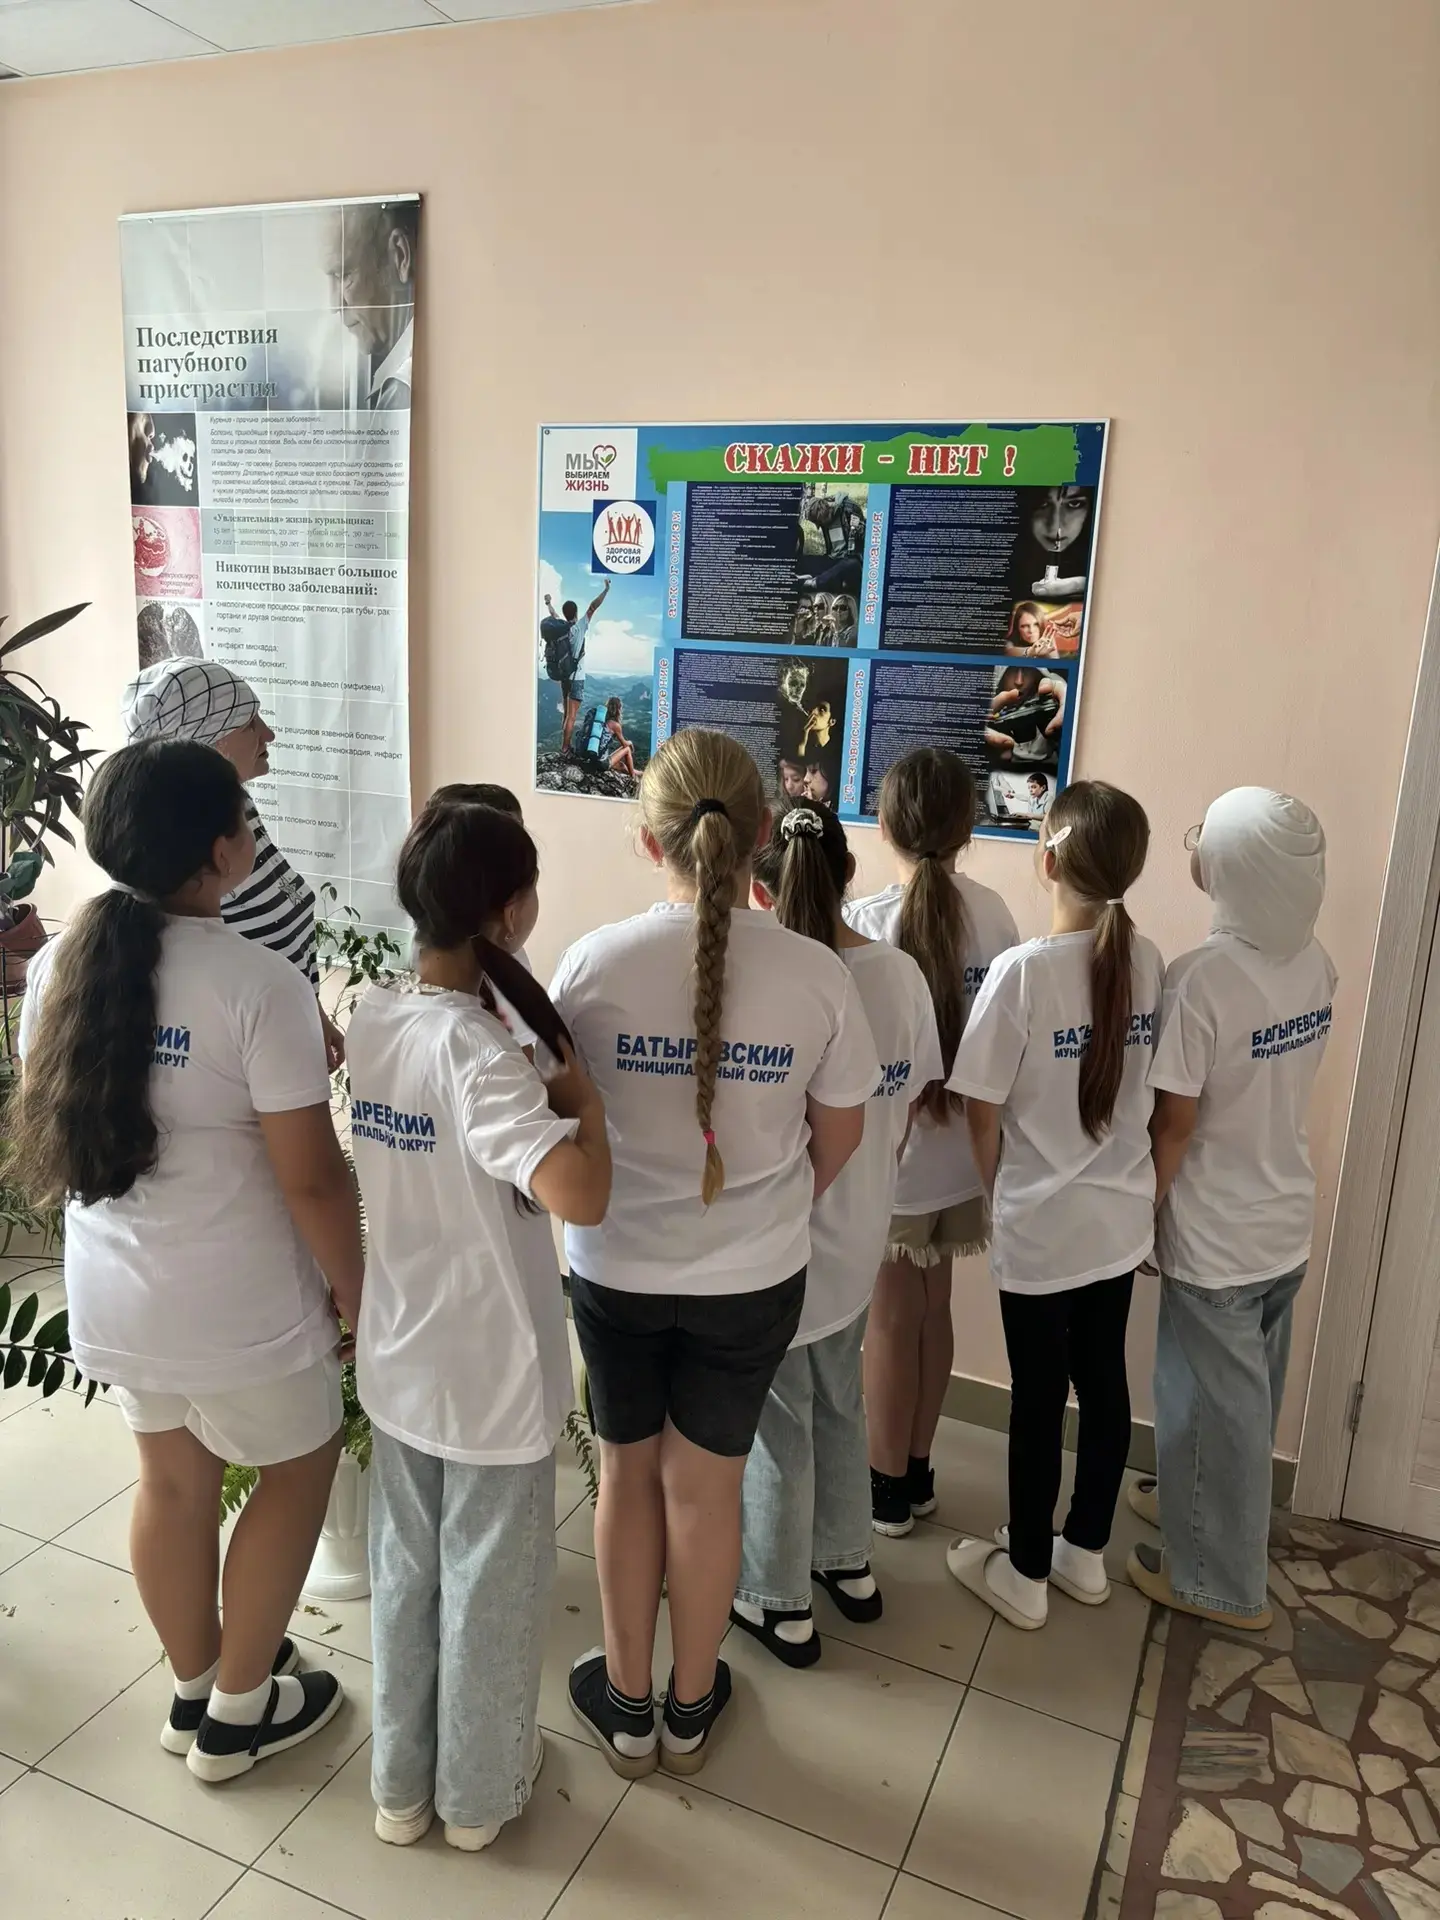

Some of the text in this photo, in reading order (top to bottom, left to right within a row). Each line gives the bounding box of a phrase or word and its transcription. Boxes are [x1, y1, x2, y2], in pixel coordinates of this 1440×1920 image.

[136, 327, 277, 349] Последствия
[138, 351, 246, 377] пагубного
[139, 382, 277, 404] пристрастия
[566, 454, 599, 470] МЫ
[724, 443, 1017, 476] СКАЖИ - НЕТ !
[565, 480, 609, 491] ЖИЗНЬ
[213, 514, 283, 524] «Увлекательная»
[315, 517, 374, 525] курильщика:
[606, 556, 640, 564] РОССИЯ
[668, 511, 681, 618] алкоголизм
[865, 511, 883, 624] наркомания
[216, 561, 398, 578] Никотин вызывает большое
[216, 580, 377, 595] количество заболеваний:
[617, 1034, 795, 1067] БАТЫРВСКИЙ
[749, 1069, 789, 1083] ОКРУГ
[399, 1138, 436, 1152] ОКРУГ
